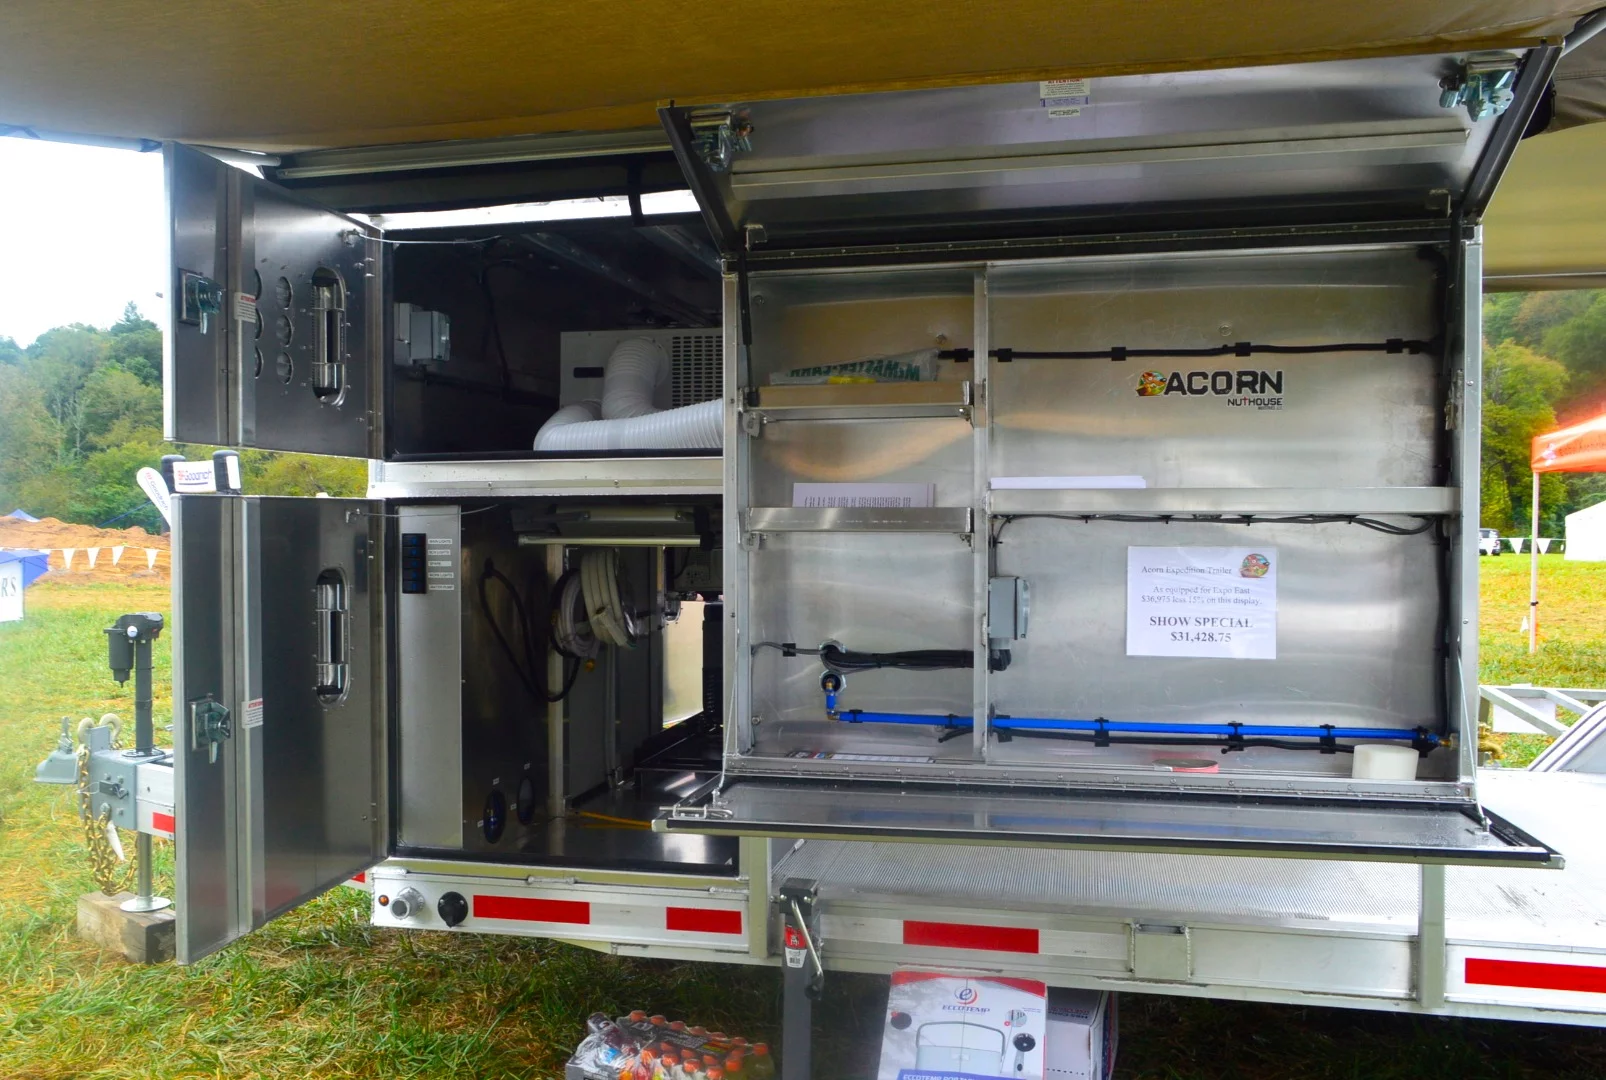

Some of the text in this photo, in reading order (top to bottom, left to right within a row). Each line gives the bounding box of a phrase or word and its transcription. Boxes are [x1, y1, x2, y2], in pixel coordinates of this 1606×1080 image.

[1164, 370, 1283, 395] ACORN
[1227, 396, 1283, 407] NUTHOUSE
[1141, 565, 1232, 576] Acorn Expedition Trailer
[1153, 585, 1250, 596] As equipped for Expo East
[1141, 594, 1171, 605] $36,975
[1172, 595, 1186, 604] less
[1206, 597, 1216, 605] on
[1217, 596, 1232, 605] this
[1149, 616, 1253, 628] SHOW SPECIAL
[1170, 631, 1232, 643] $31,428.75
[942, 1005, 991, 1013] ECCOTEMP
